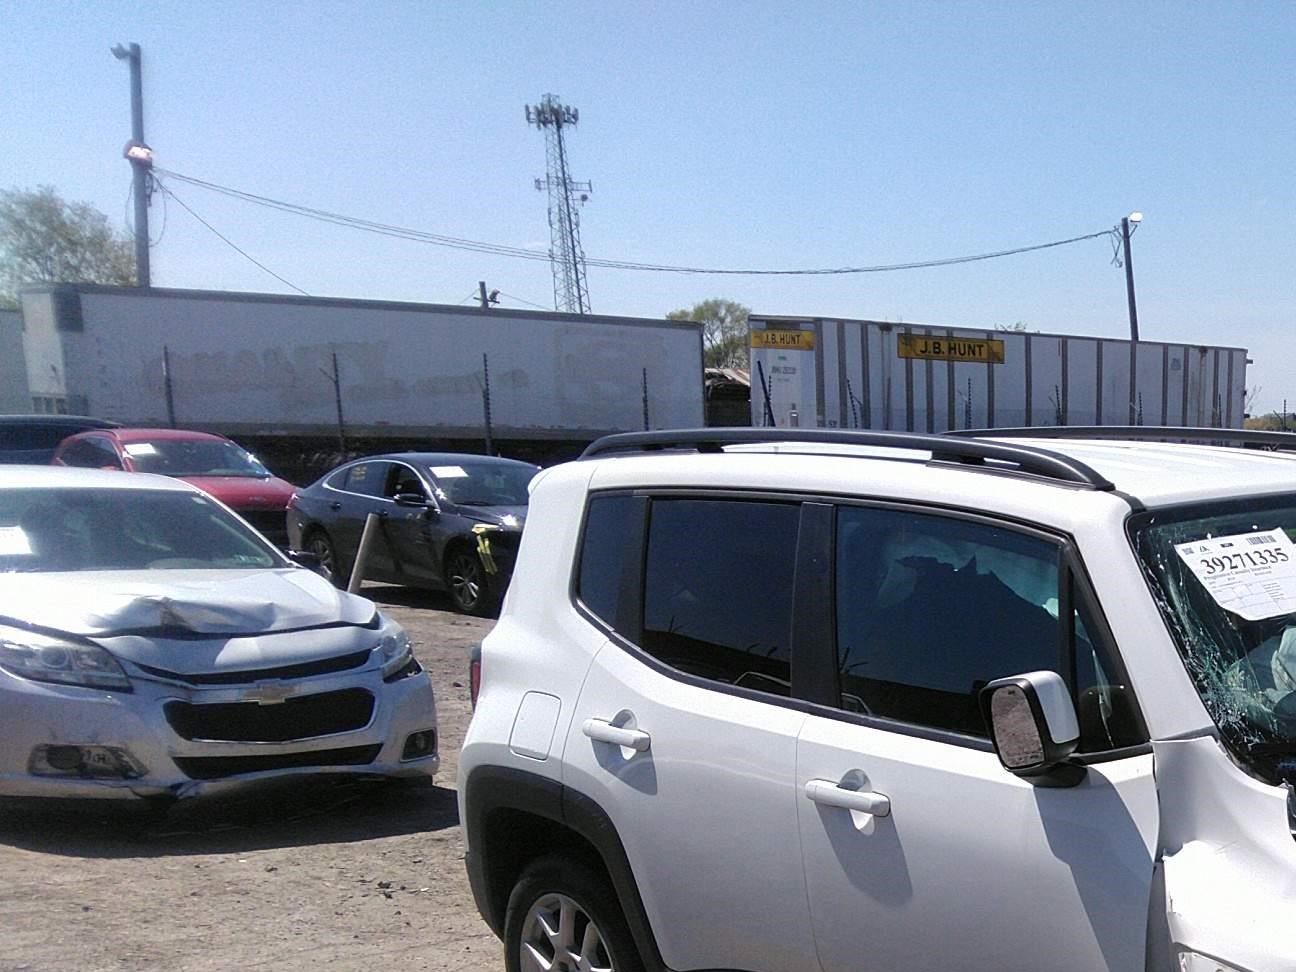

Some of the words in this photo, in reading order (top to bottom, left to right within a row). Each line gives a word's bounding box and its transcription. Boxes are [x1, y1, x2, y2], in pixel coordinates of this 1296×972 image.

[779, 333, 801, 345] HUNT
[919, 341, 945, 355] J.B.
[948, 342, 984, 357] HUNT
[1200, 547, 1289, 575] 39271335
